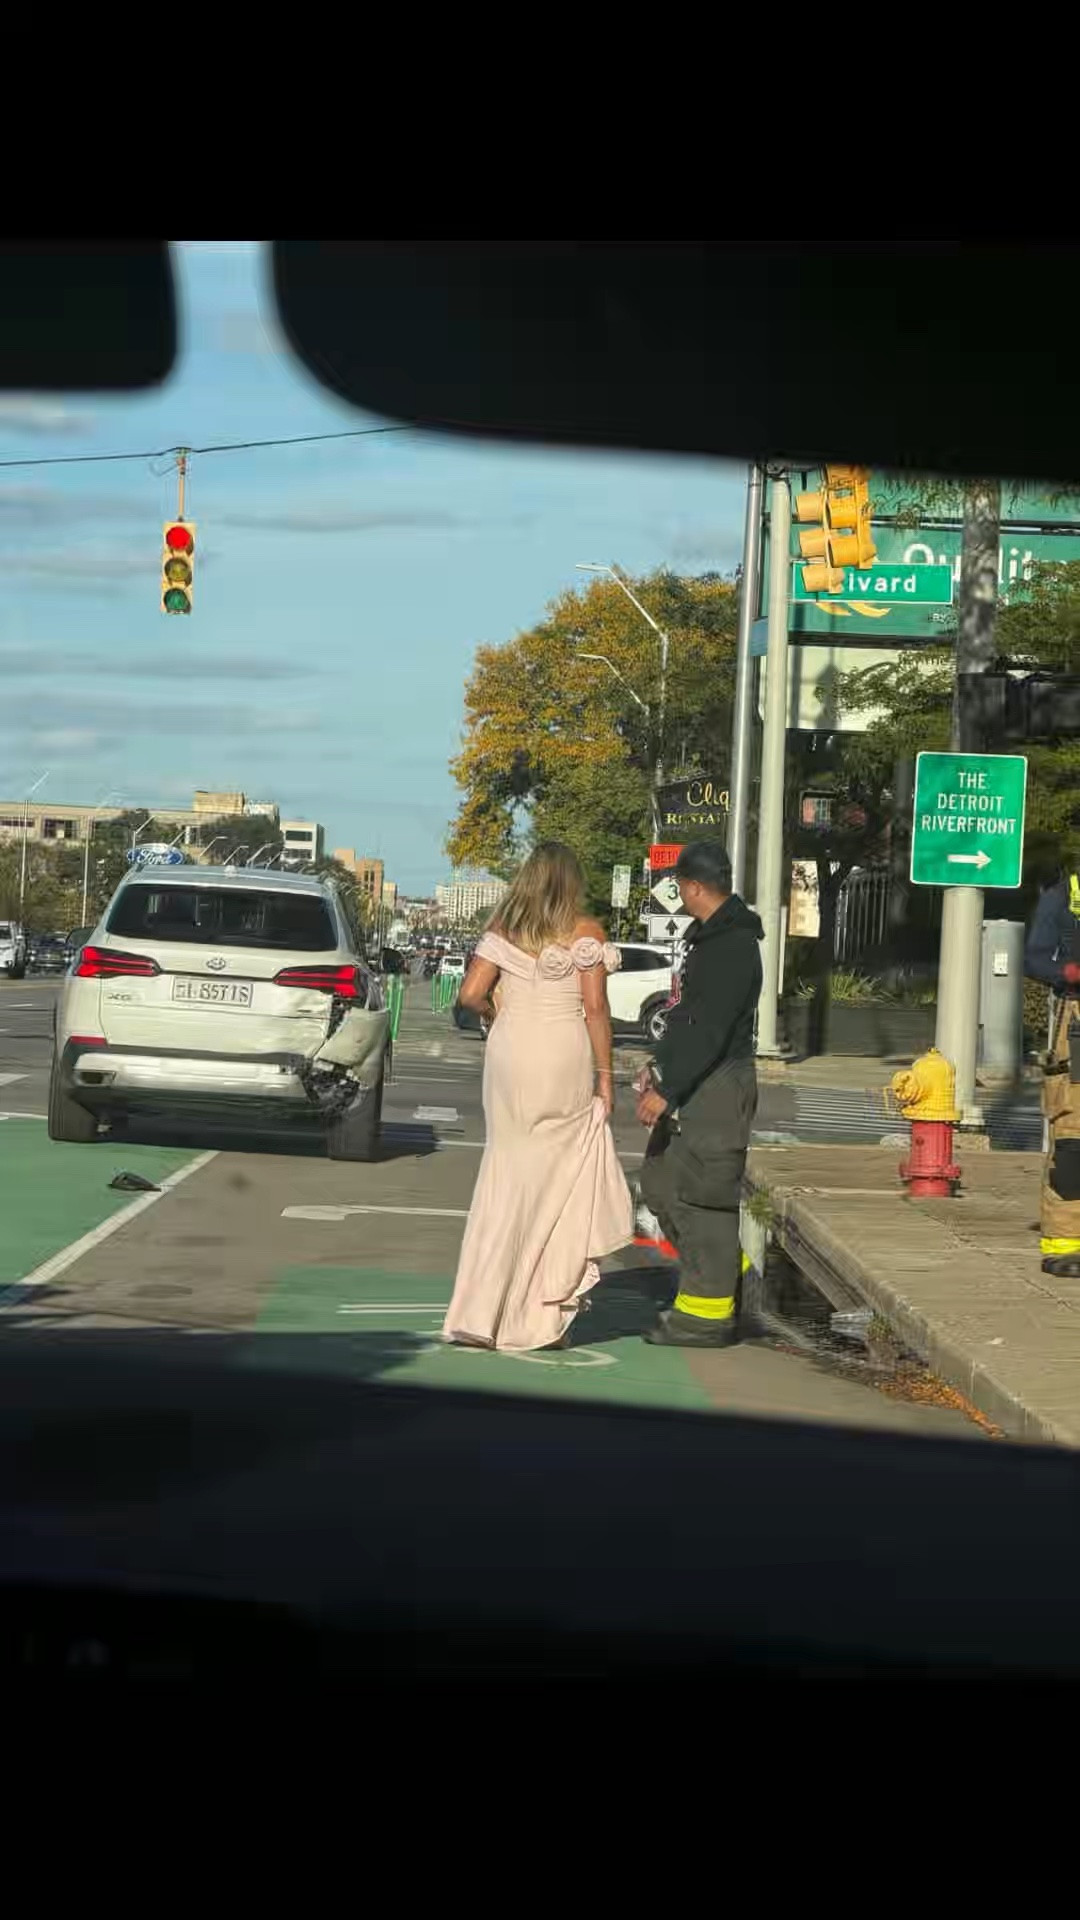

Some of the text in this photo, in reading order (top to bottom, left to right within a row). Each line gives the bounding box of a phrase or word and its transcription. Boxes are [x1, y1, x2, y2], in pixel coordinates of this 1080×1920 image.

[838, 573, 917, 593] ivard
[958, 772, 987, 790] THE
[937, 793, 1004, 813] DETROIT
[921, 814, 1017, 835] RIVERFRONT
[136, 848, 173, 865] Ford
[667, 884, 679, 900] 3
